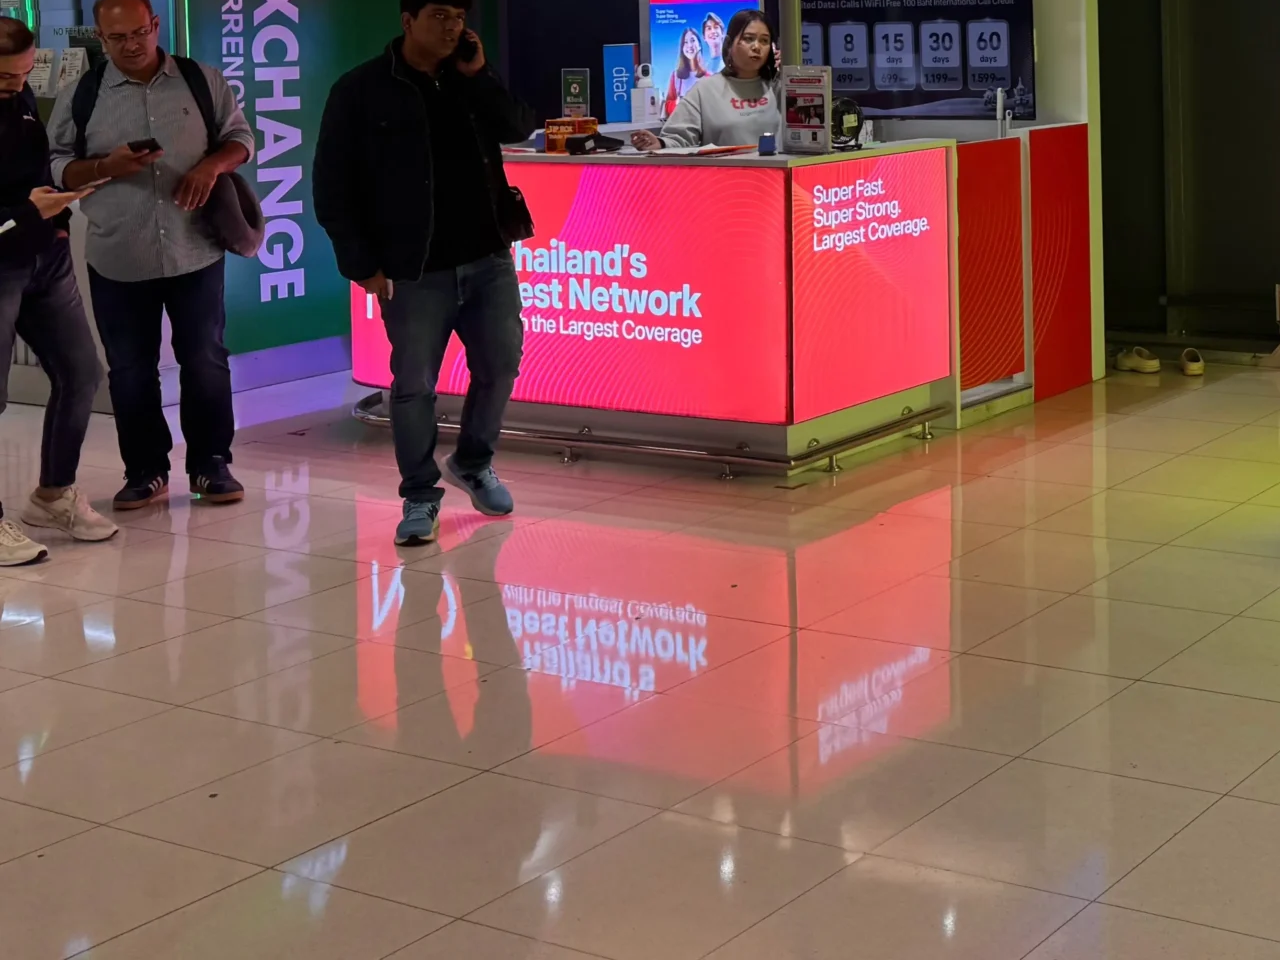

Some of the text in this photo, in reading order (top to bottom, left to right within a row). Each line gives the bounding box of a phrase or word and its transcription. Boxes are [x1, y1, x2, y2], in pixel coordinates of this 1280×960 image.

[817, 0, 836, 9] Data
[840, 0, 860, 8] Calls
[843, 33, 855, 52] 8
[881, 33, 905, 52] 15
[928, 32, 954, 52] 30
[976, 31, 1001, 51] 60
[841, 54, 998, 65] days days days days
[612, 66, 630, 102] dtac
[836, 73, 853, 83] 499
[881, 73, 898, 84] 699
[730, 96, 769, 110] true
[813, 178, 886, 206] Super Fast.
[813, 200, 901, 229] Super Strong.
[813, 216, 930, 252] Largest Coverage.
[511, 238, 648, 279] hailand's
[518, 277, 703, 318] est Network
[531, 313, 557, 333] the
[559, 315, 619, 341] Largest
[622, 319, 703, 348] Coverage
